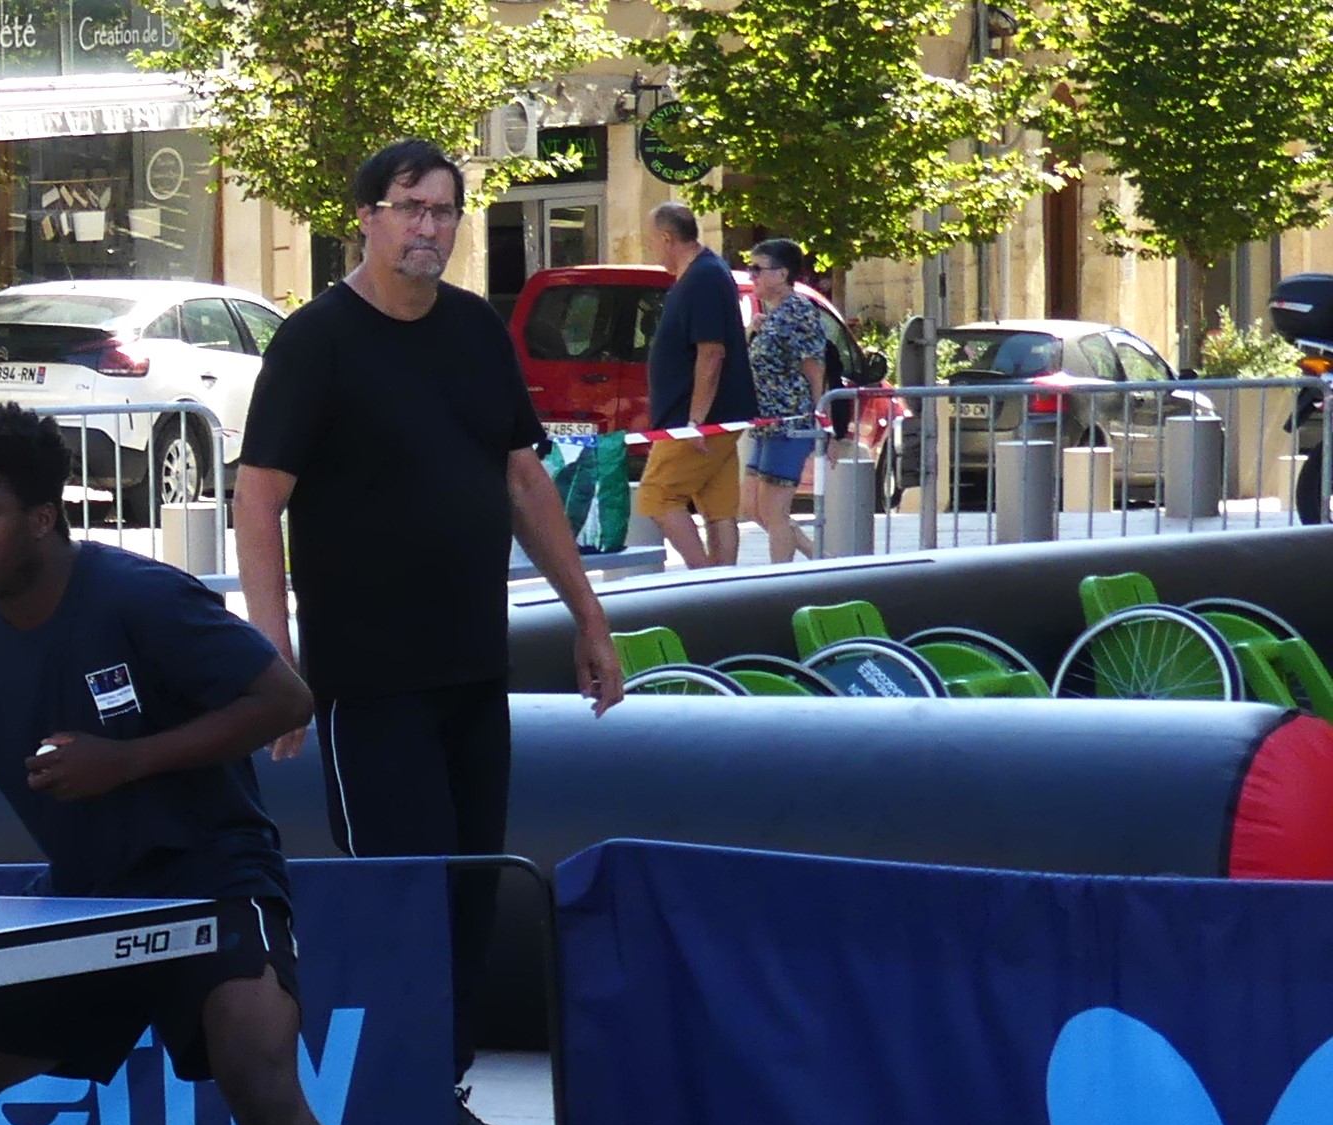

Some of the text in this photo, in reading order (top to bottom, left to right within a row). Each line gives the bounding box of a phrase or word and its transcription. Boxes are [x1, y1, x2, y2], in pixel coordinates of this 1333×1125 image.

[79, 16, 140, 51] Création
[142, 15, 159, 44] de
[114, 930, 171, 960] 540
